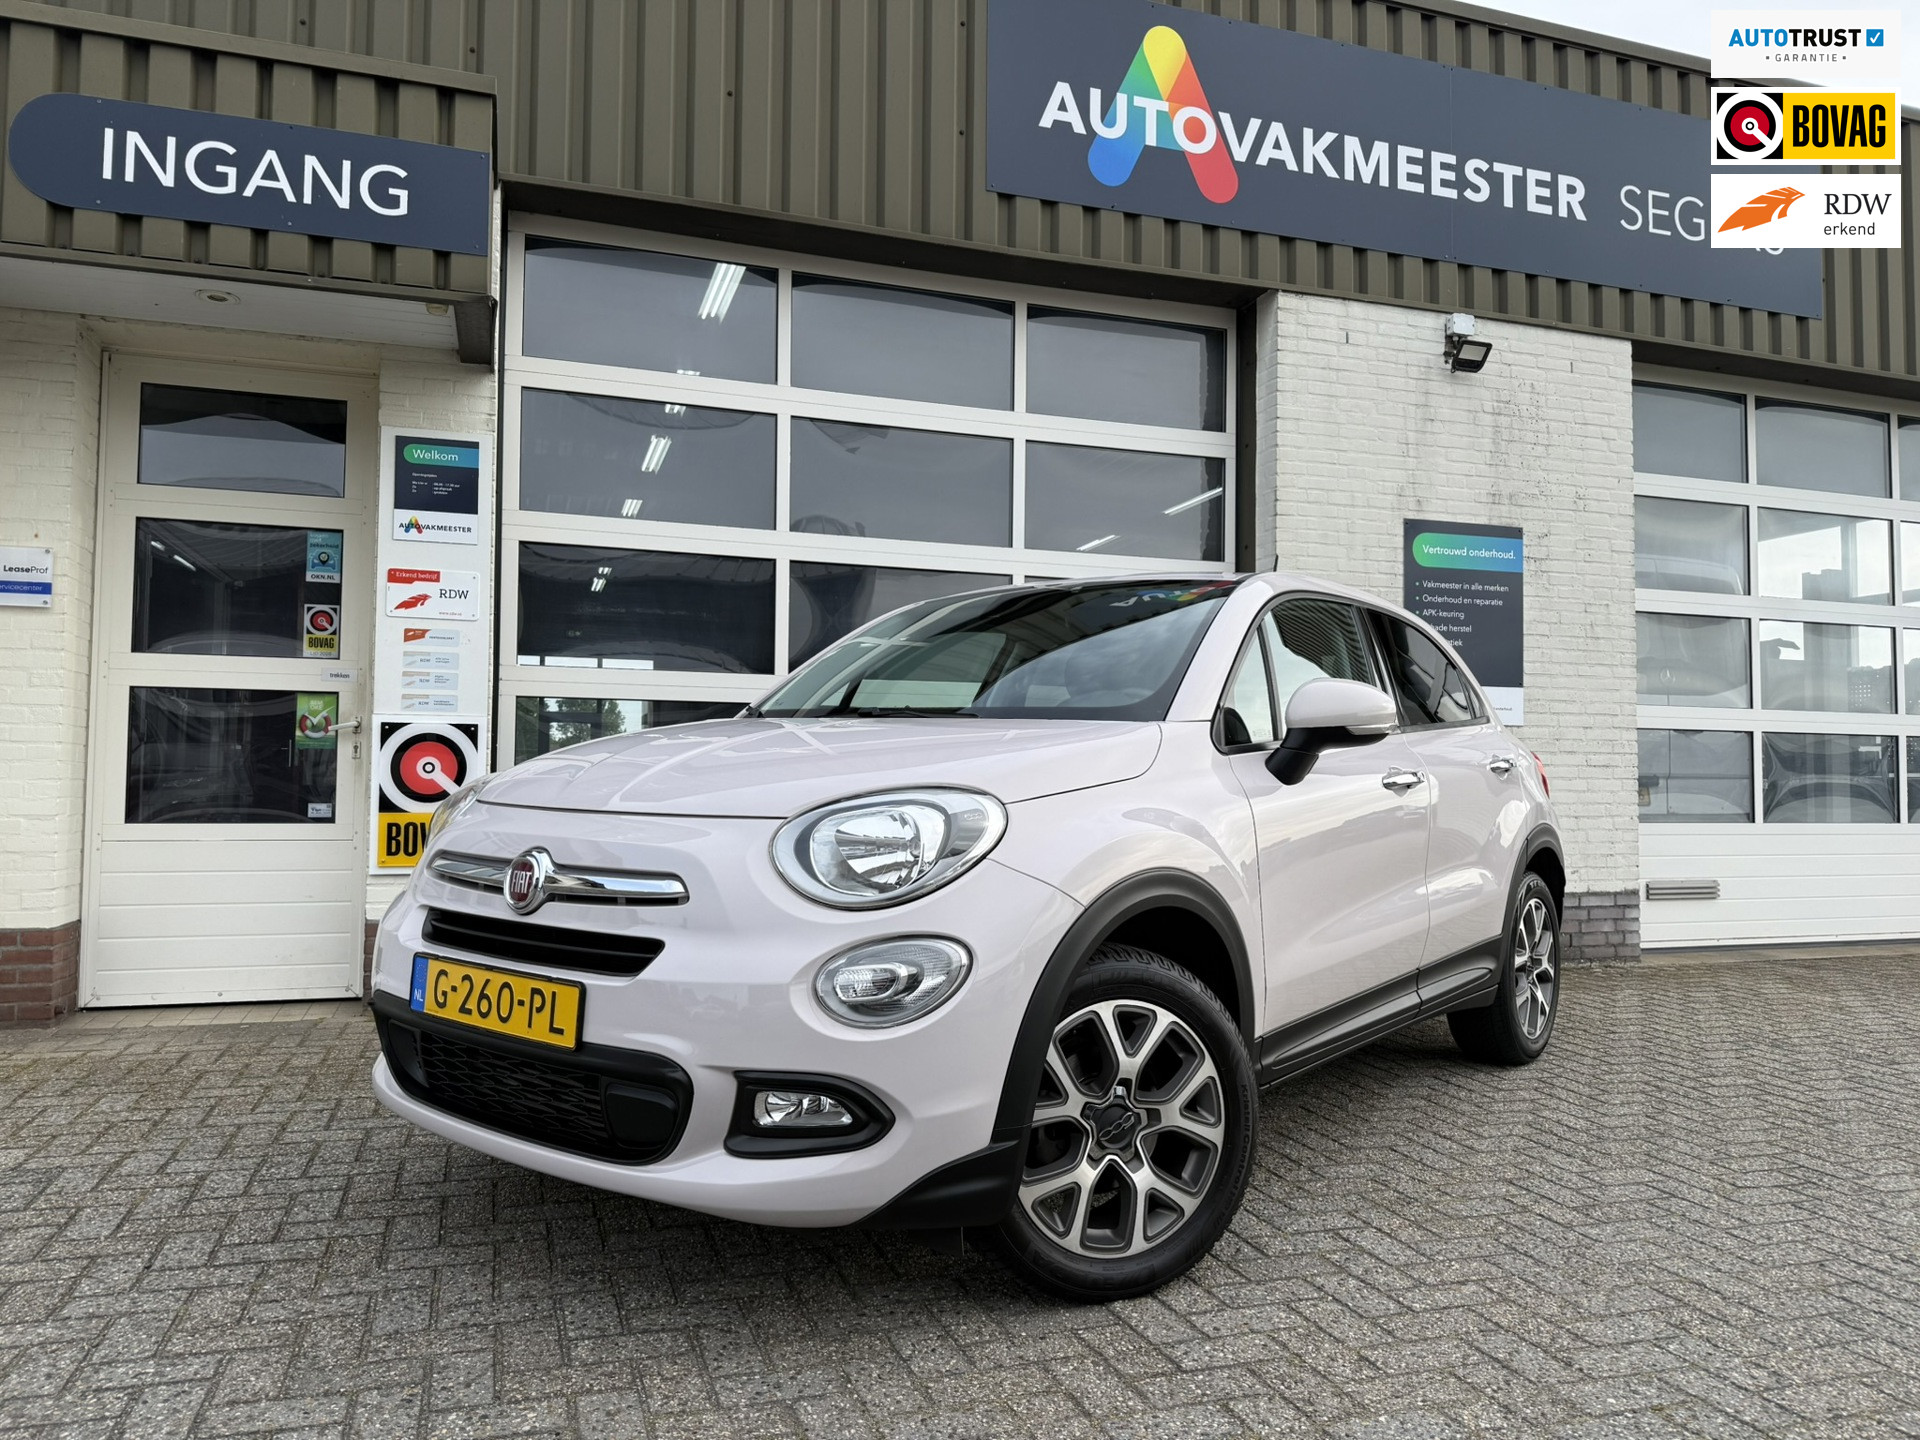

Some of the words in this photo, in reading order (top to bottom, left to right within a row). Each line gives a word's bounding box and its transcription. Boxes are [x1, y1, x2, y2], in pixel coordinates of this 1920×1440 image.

[1038, 80, 1587, 222] AUTOVAKMEESTER
[102, 127, 409, 216] INGANG
[412, 449, 459, 462] Welkom
[398, 522, 472, 533] AUTOVAKMEESTER
[1422, 544, 1468, 556] Vertrouwd
[1468, 548, 1516, 560] onderhoud.
[3, 565, 48, 574] LeaseProf
[310, 573, 336, 581] OKN.NL
[418, 573, 438, 581] bedrijf
[1422, 580, 1462, 591] Vakmeester
[1463, 582, 1470, 590] in
[1470, 583, 1483, 591] alle
[1484, 584, 1510, 592] merken
[439, 588, 469, 600] RDW
[1422, 593, 1463, 604] Onderhoud
[1473, 598, 1504, 607] reparatie
[1422, 608, 1465, 620] APK-keuring
[1448, 623, 1472, 633] herstel
[308, 637, 335, 649] BOVAG
[510, 870, 532, 894] FIAT
[413, 988, 424, 1002] NL
[433, 968, 565, 1035] G-260-PL
